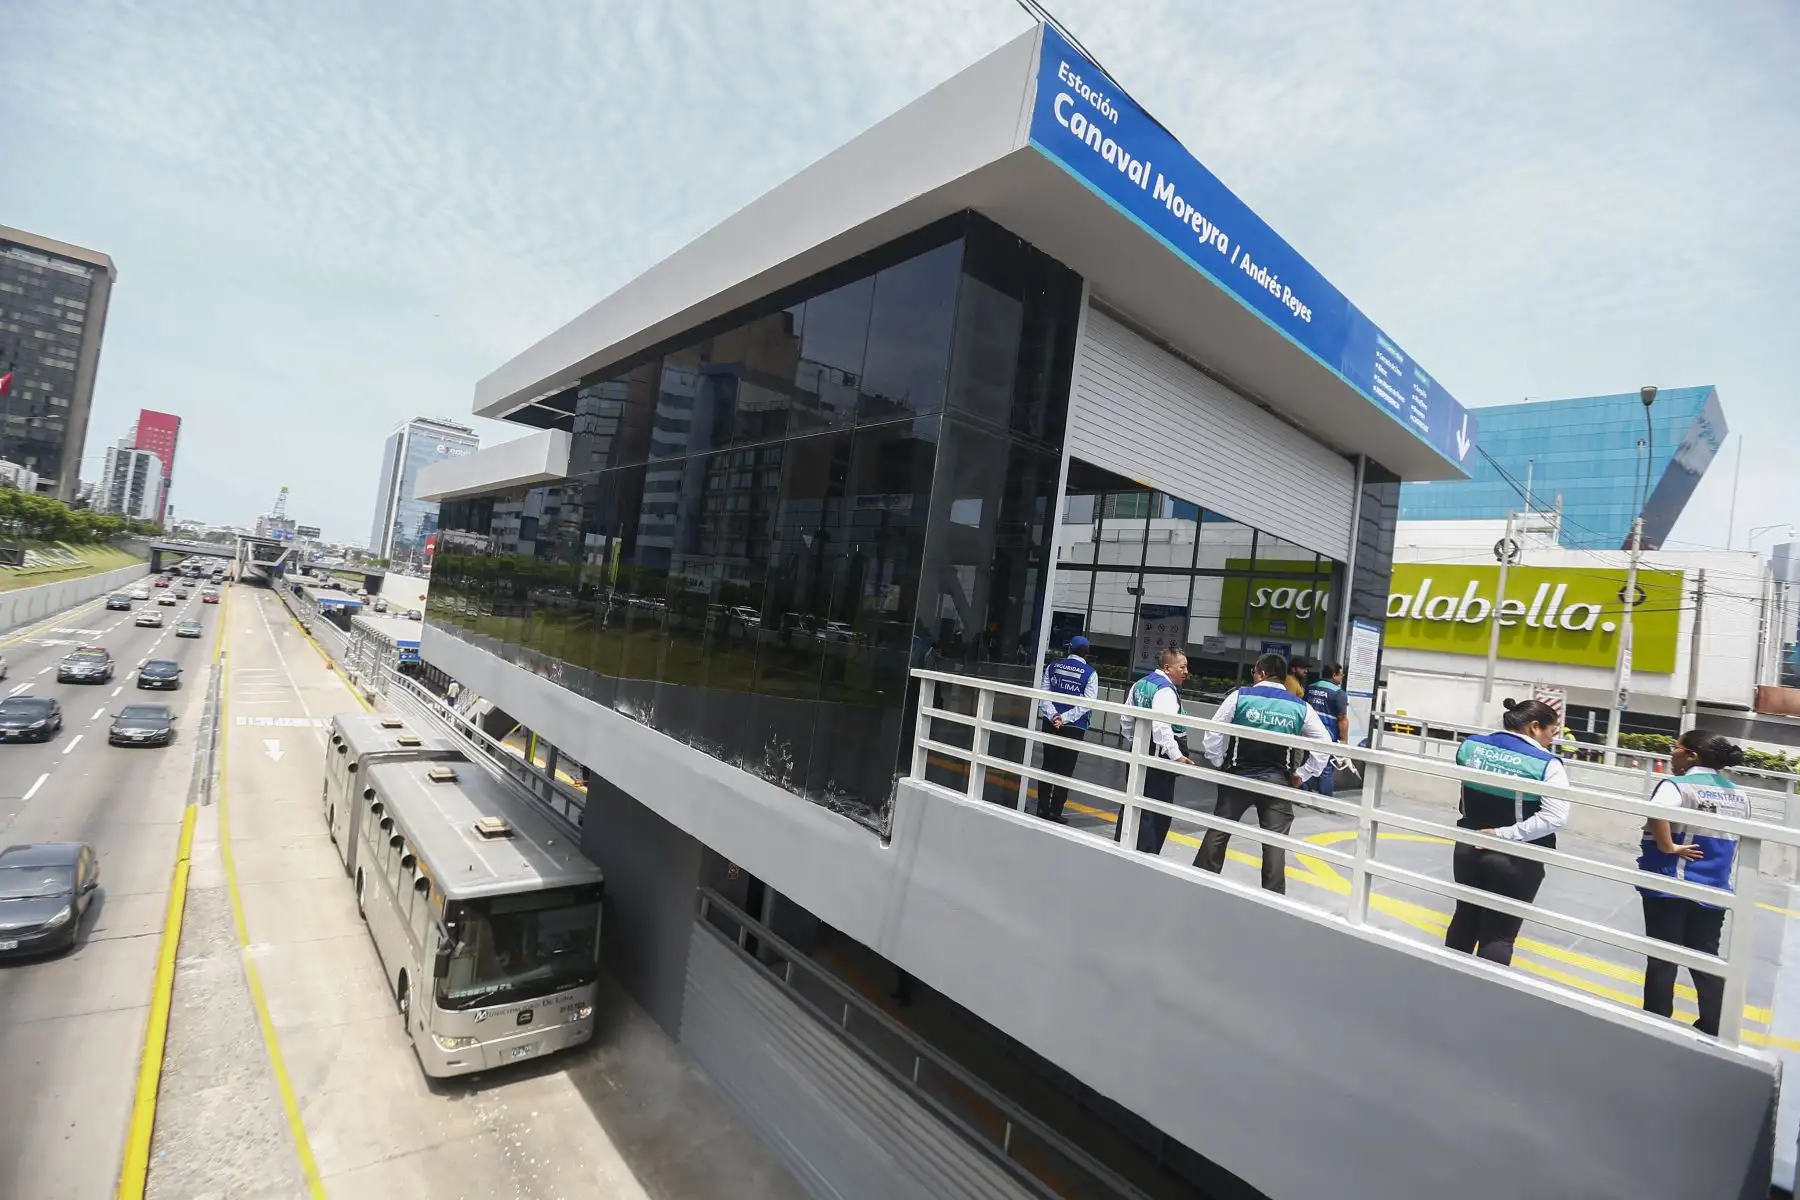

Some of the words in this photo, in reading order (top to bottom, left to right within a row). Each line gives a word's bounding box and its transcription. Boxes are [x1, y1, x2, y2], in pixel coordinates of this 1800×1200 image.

[1058, 60, 1119, 125] Estación
[1053, 92, 1152, 190] Canaval
[1152, 172, 1230, 254] Moreyra
[1239, 252, 1282, 298] Andrés
[1282, 285, 1313, 323] Reyes
[1386, 578, 1617, 632] alabella.
[1060, 682, 1082, 693] LIMA
[1262, 714, 1295, 729] LIMA
